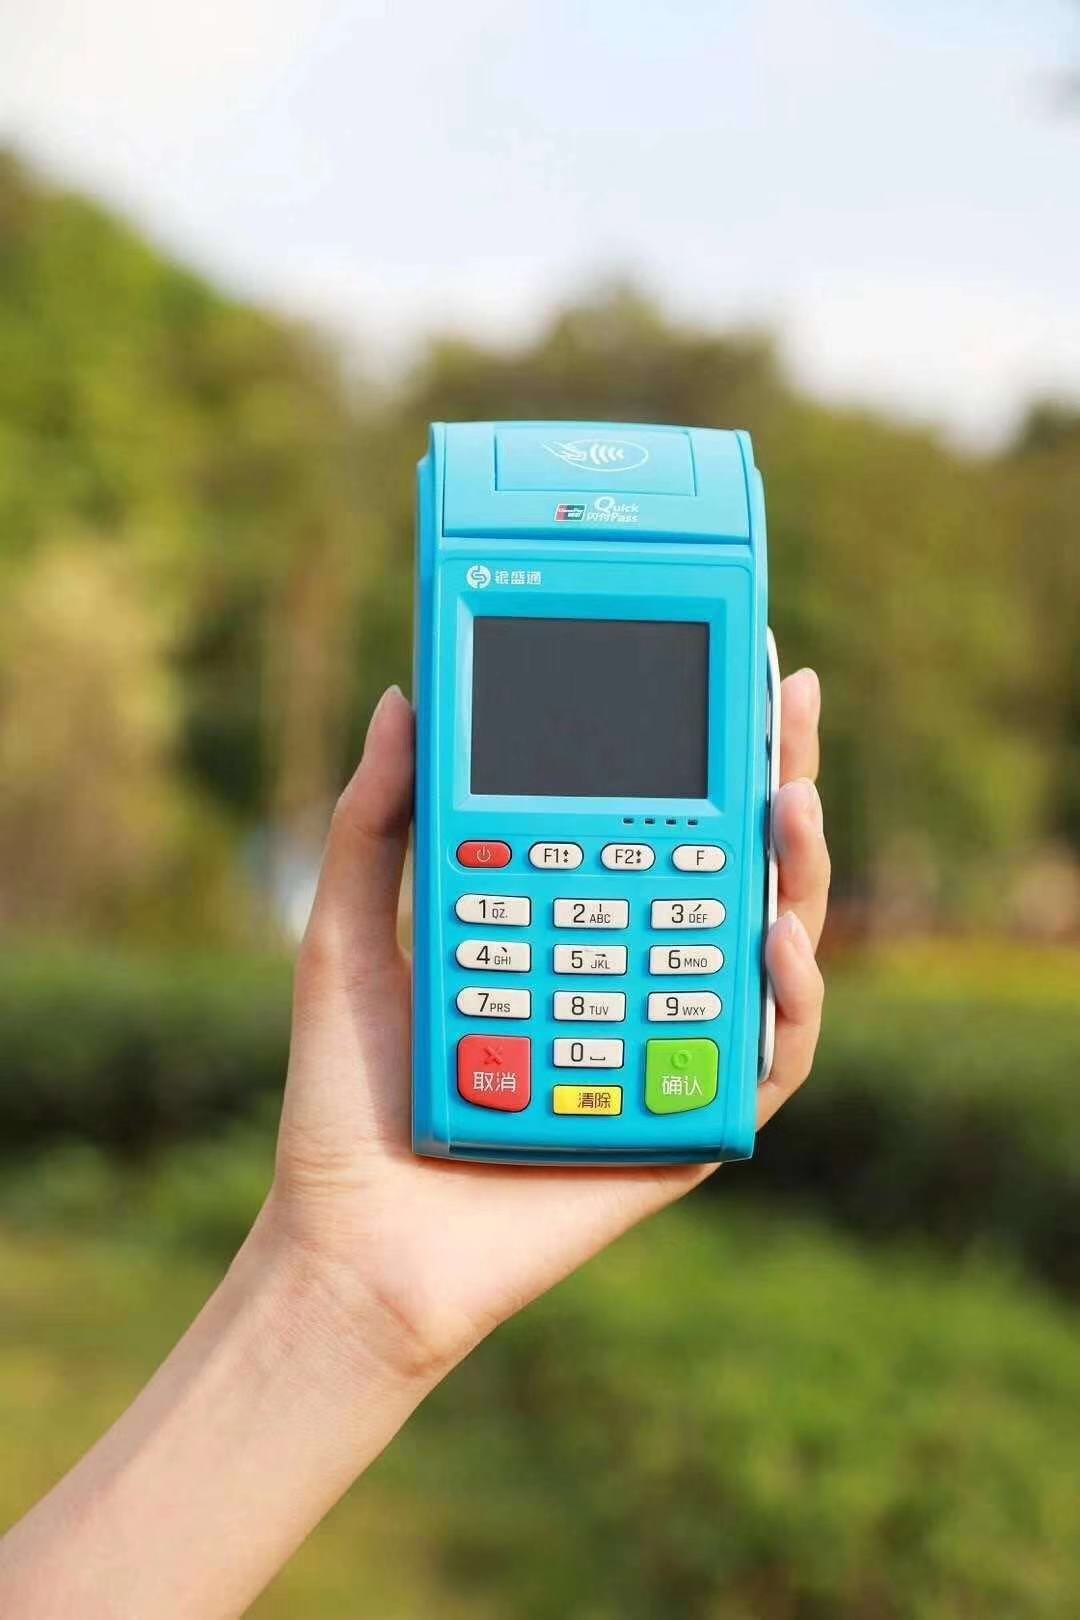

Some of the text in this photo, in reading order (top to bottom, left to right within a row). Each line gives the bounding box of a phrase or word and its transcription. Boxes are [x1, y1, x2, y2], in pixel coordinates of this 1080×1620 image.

[594, 496, 639, 513] Quick
[495, 570, 541, 585] 银盛通
[544, 848, 559, 863] F1
[615, 849, 633, 864] F2
[695, 850, 705, 866] F
[478, 899, 487, 919] 1
[573, 903, 611, 924] 2 ABC
[671, 903, 708, 923] 3 DEF
[476, 945, 511, 966] 4 GHI
[571, 950, 610, 970] 5 JKL
[668, 950, 708, 969] 6 MNO
[477, 992, 511, 1013] 7 PRS
[571, 996, 609, 1015] 8 TUV
[665, 996, 706, 1016] 9 WXY
[570, 1042, 583, 1062] 0
[472, 1071, 517, 1093] 取消
[661, 1075, 703, 1096] 确认
[577, 1092, 611, 1109] 清除
